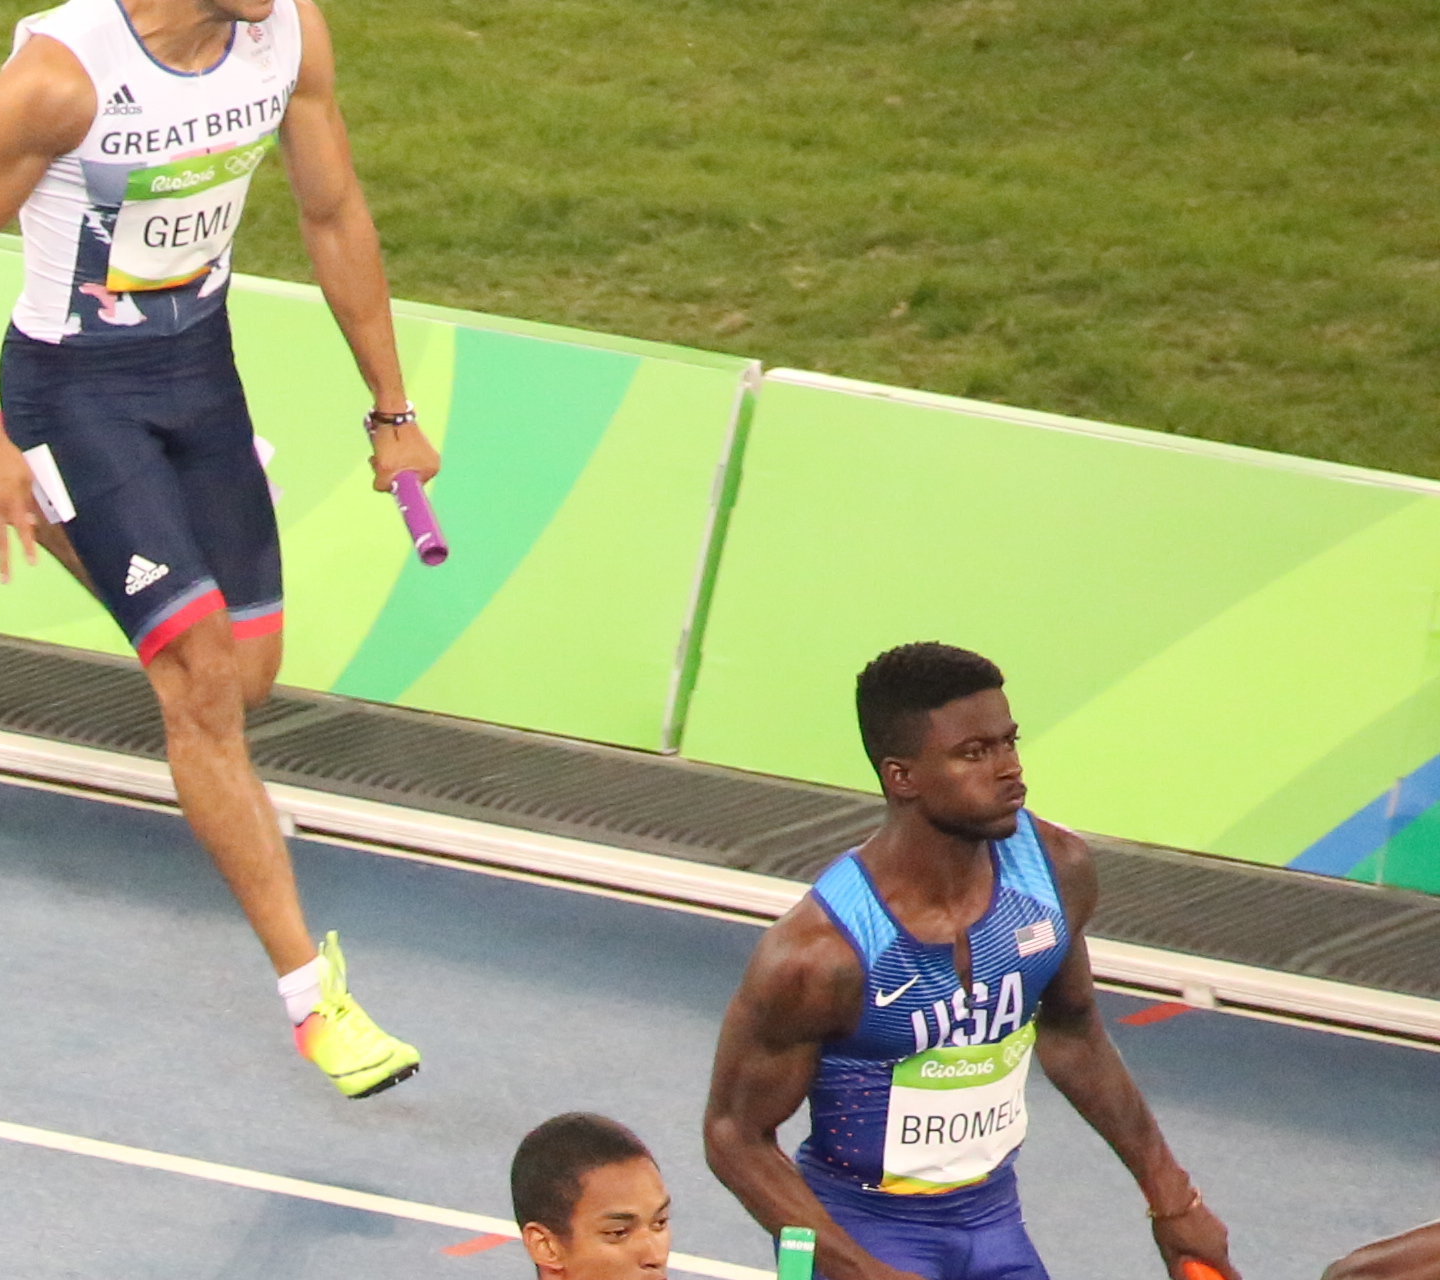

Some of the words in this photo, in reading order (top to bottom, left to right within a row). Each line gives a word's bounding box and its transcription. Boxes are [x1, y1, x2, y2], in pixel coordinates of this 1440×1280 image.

[100, 118, 199, 156] GREAT
[150, 165, 216, 193] Rio2016
[911, 971, 1024, 1054] USA
[920, 1057, 995, 1079] Rio2016
